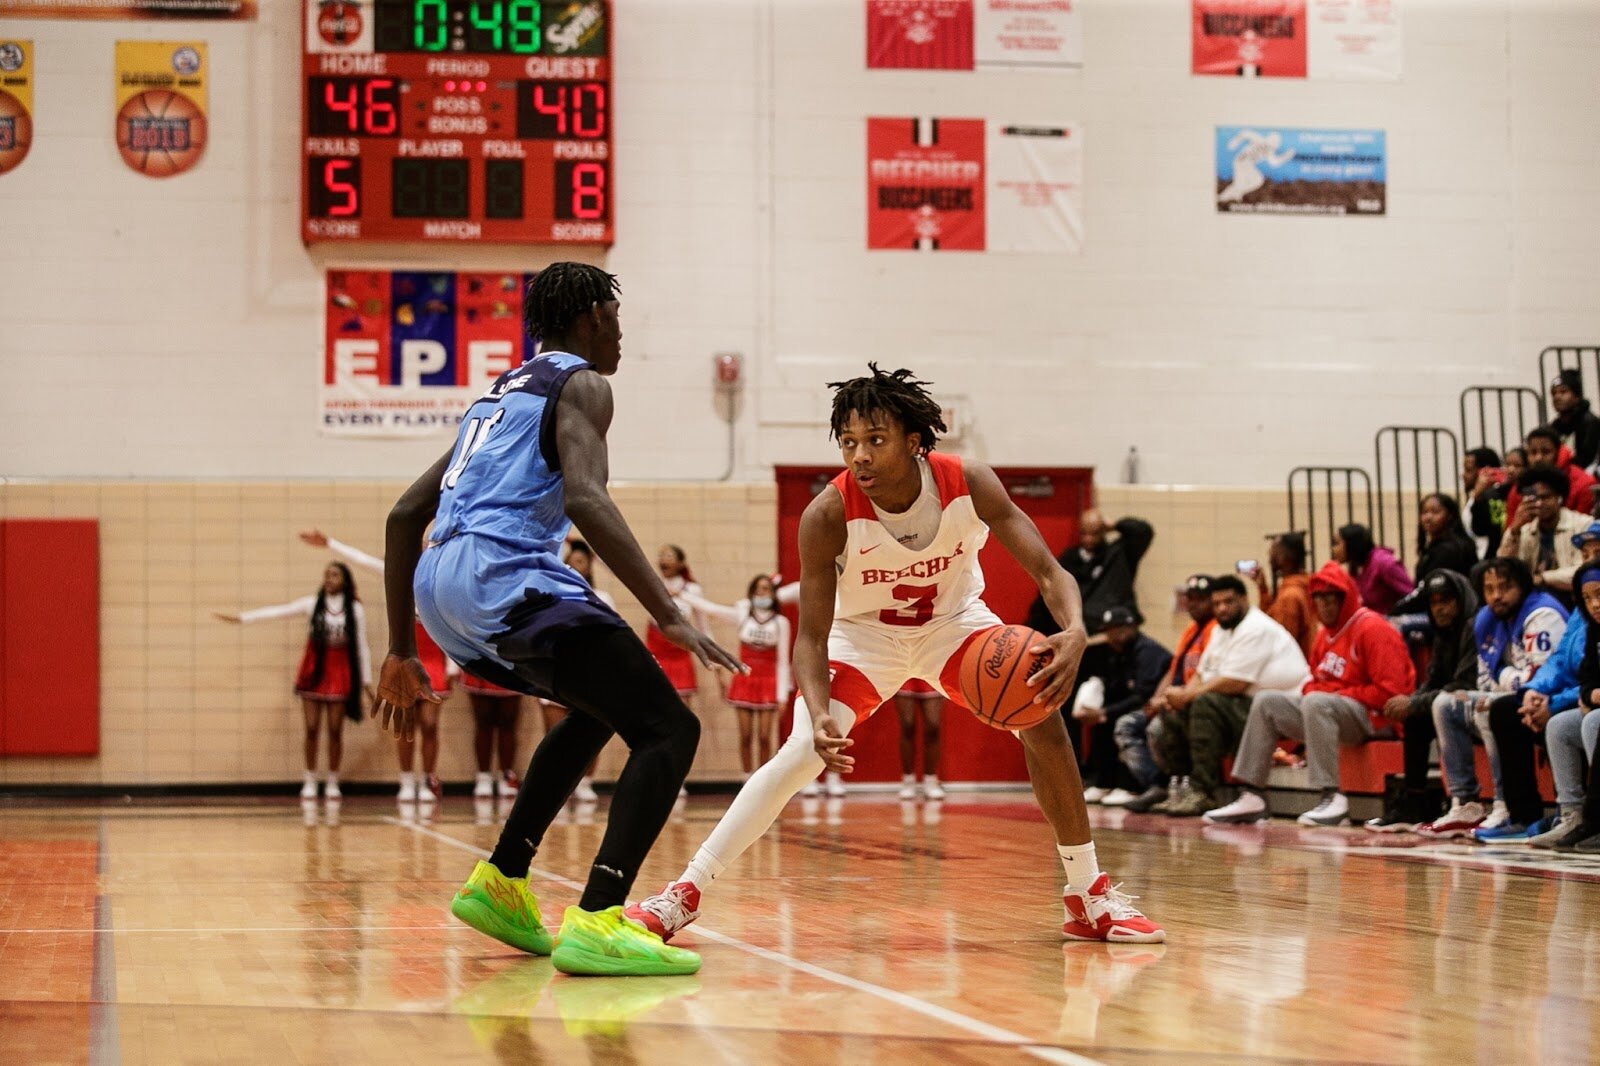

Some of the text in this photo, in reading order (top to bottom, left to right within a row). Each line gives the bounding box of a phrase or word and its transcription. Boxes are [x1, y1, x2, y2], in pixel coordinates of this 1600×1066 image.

[414, 0, 541, 53] 0:48
[320, 55, 387, 75] HOME
[427, 60, 490, 76] PERIOD
[525, 57, 600, 78] GUEST
[325, 79, 397, 134] 46
[533, 83, 606, 138] 40
[428, 117, 488, 134] BONUS
[306, 138, 360, 155] FOULS
[399, 140, 464, 156] PLAYER
[482, 141, 526, 157] FOUL
[553, 142, 608, 158] FOULS
[324, 160, 357, 216] 5
[572, 163, 606, 219] 8
[307, 221, 361, 238] SCORE
[424, 223, 481, 239] MATCH
[552, 223, 606, 239] SCORE
[879, 582, 939, 627] 3
[1524, 630, 1552, 653] 76
